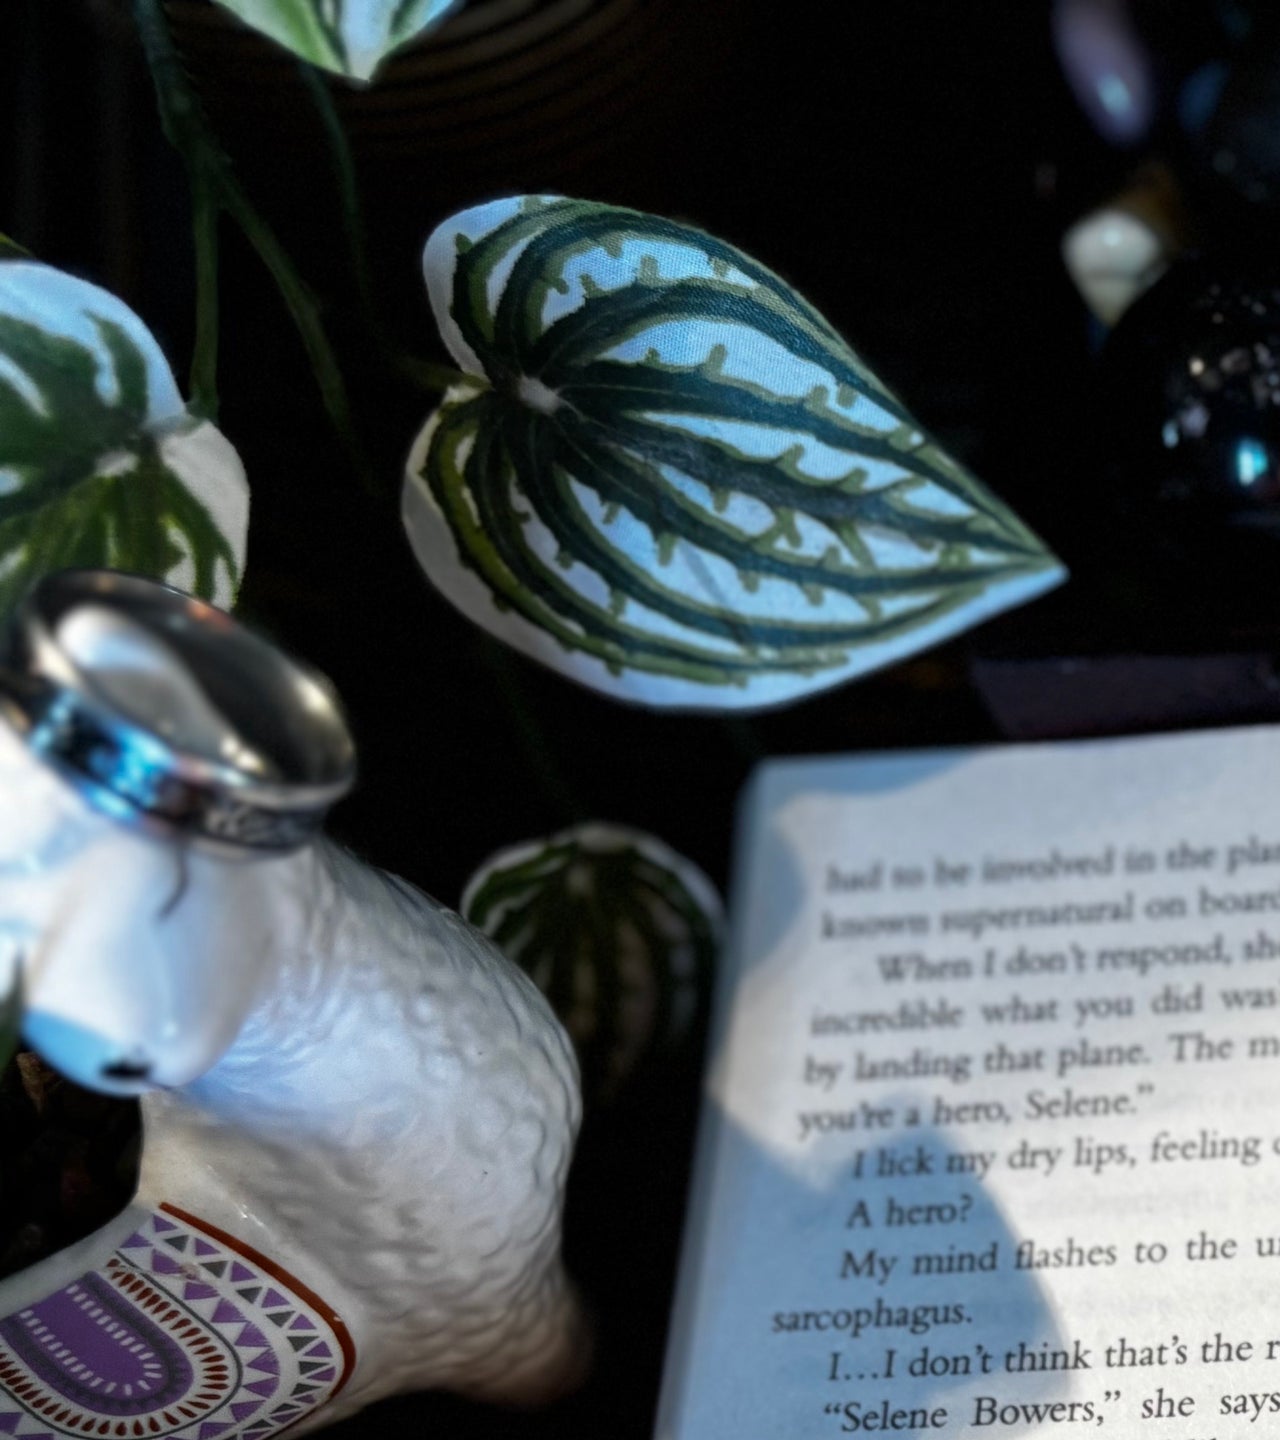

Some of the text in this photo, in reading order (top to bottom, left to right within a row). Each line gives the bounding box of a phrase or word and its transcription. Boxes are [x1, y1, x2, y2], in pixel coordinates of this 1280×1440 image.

[797, 1082, 1156, 1139] you’re a hero, Selene.”
[850, 1149, 867, 1182] I
[874, 1144, 935, 1180] lick
[943, 1150, 997, 1176] my
[1005, 1138, 1064, 1177] dry
[1072, 1135, 1138, 1176] lips,
[1149, 1128, 1263, 1168] feeling
[827, 1348, 897, 1382] I...I
[907, 1343, 994, 1379] don’t
[1003, 1339, 1092, 1374] think
[1104, 1333, 1189, 1369] that’s
[1200, 1331, 1254, 1365] the
